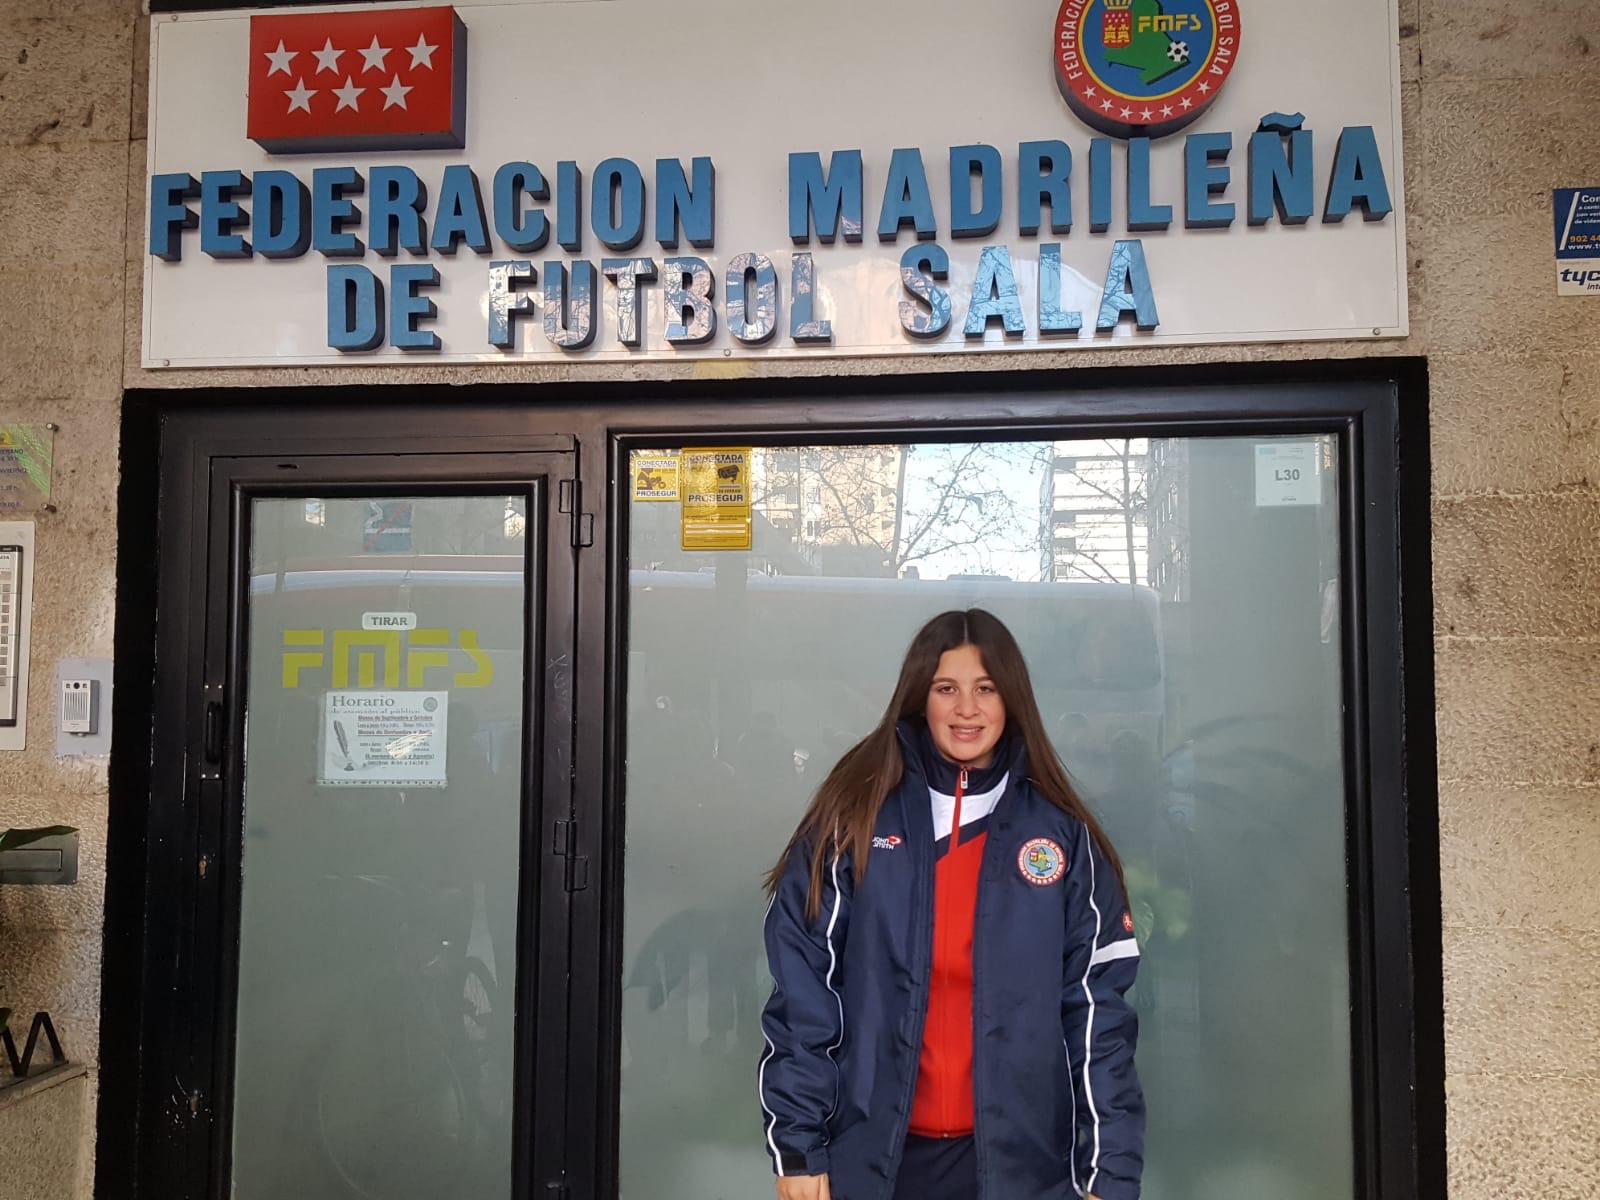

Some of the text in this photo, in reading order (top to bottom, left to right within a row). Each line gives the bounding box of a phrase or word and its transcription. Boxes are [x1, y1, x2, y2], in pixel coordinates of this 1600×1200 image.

[1138, 14, 1202, 33] FMFS
[1209, 0, 1234, 75] BOL SALA
[150, 112, 1393, 261] FEDERACION MADRILEÑA
[1570, 235, 1588, 243] 902
[327, 239, 1161, 352] DE FUTBOL SALA
[689, 454, 744, 462] CONECTADA
[1274, 468, 1300, 481] L30
[688, 494, 744, 502] PROSEGUR
[371, 616, 408, 626] TIRAR
[282, 628, 494, 688] FMFS
[332, 695, 395, 707] Horario
